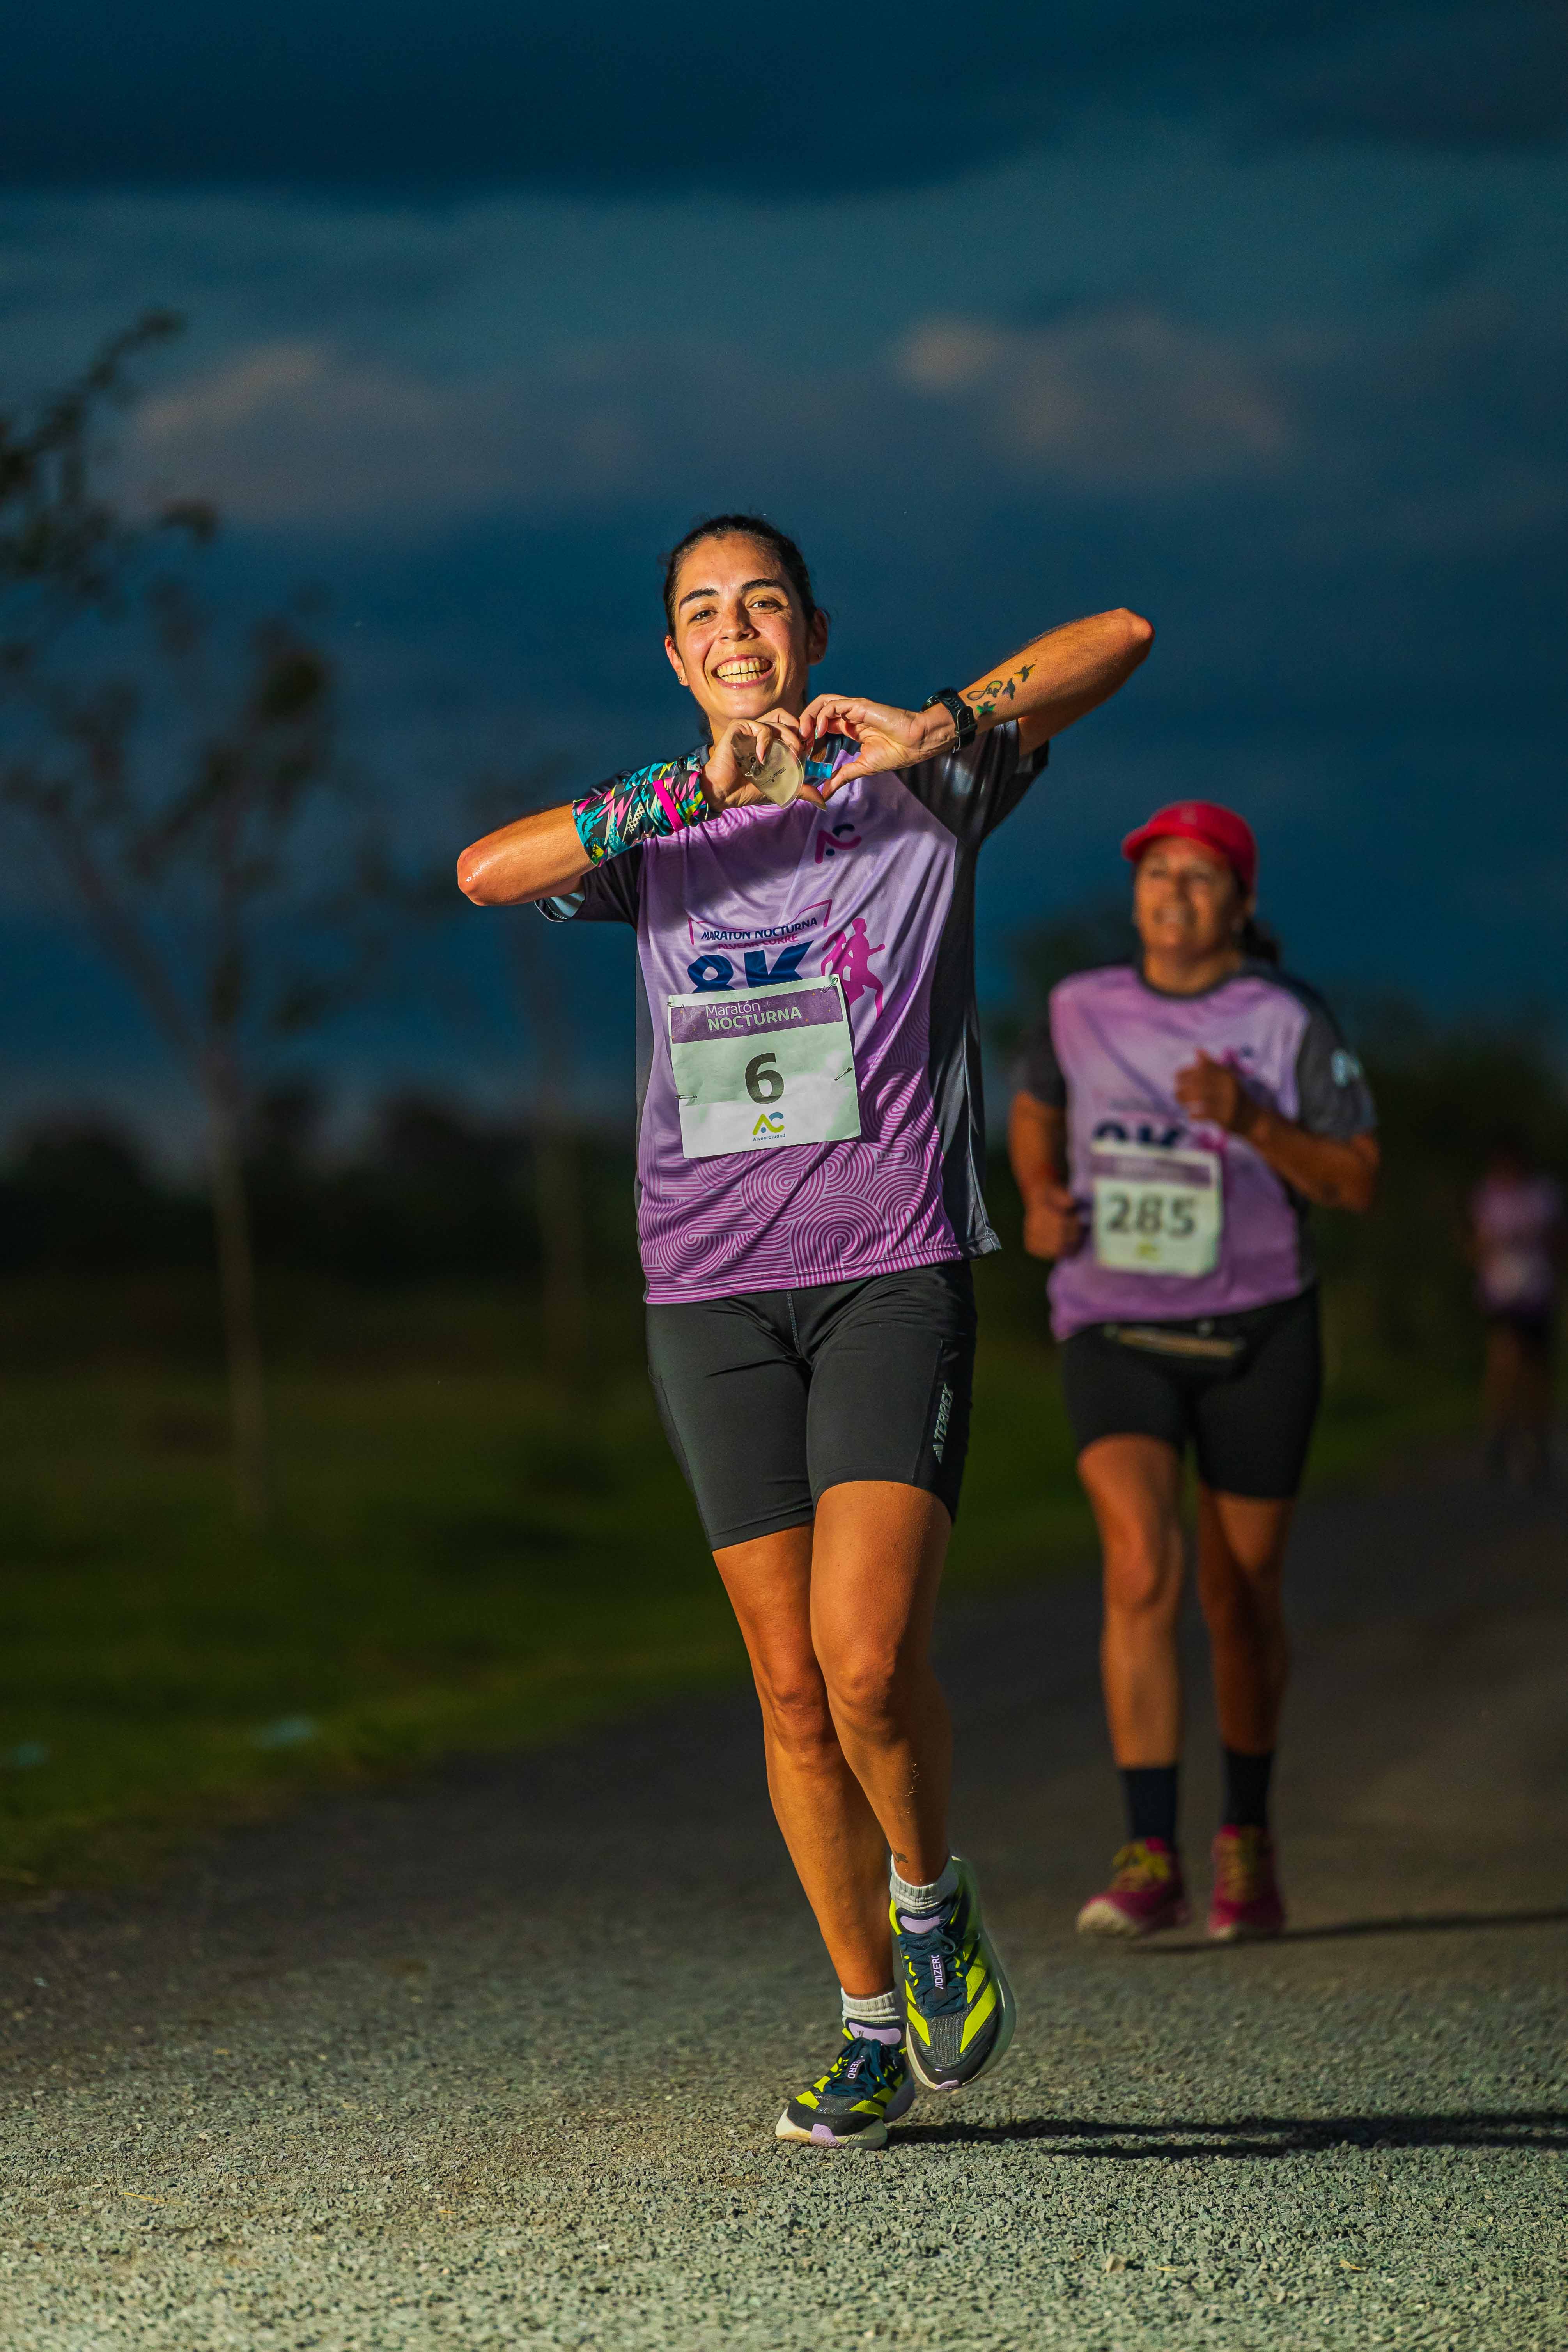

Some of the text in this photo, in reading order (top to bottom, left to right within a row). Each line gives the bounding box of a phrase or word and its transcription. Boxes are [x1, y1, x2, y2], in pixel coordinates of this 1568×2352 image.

[755, 917, 818, 939] NOCTURNA
[707, 1002, 760, 1017] Maratón
[707, 1006, 802, 1031] NOCTURNA
[745, 1052, 784, 1104] 6
[1107, 1194, 1196, 1238] 285
